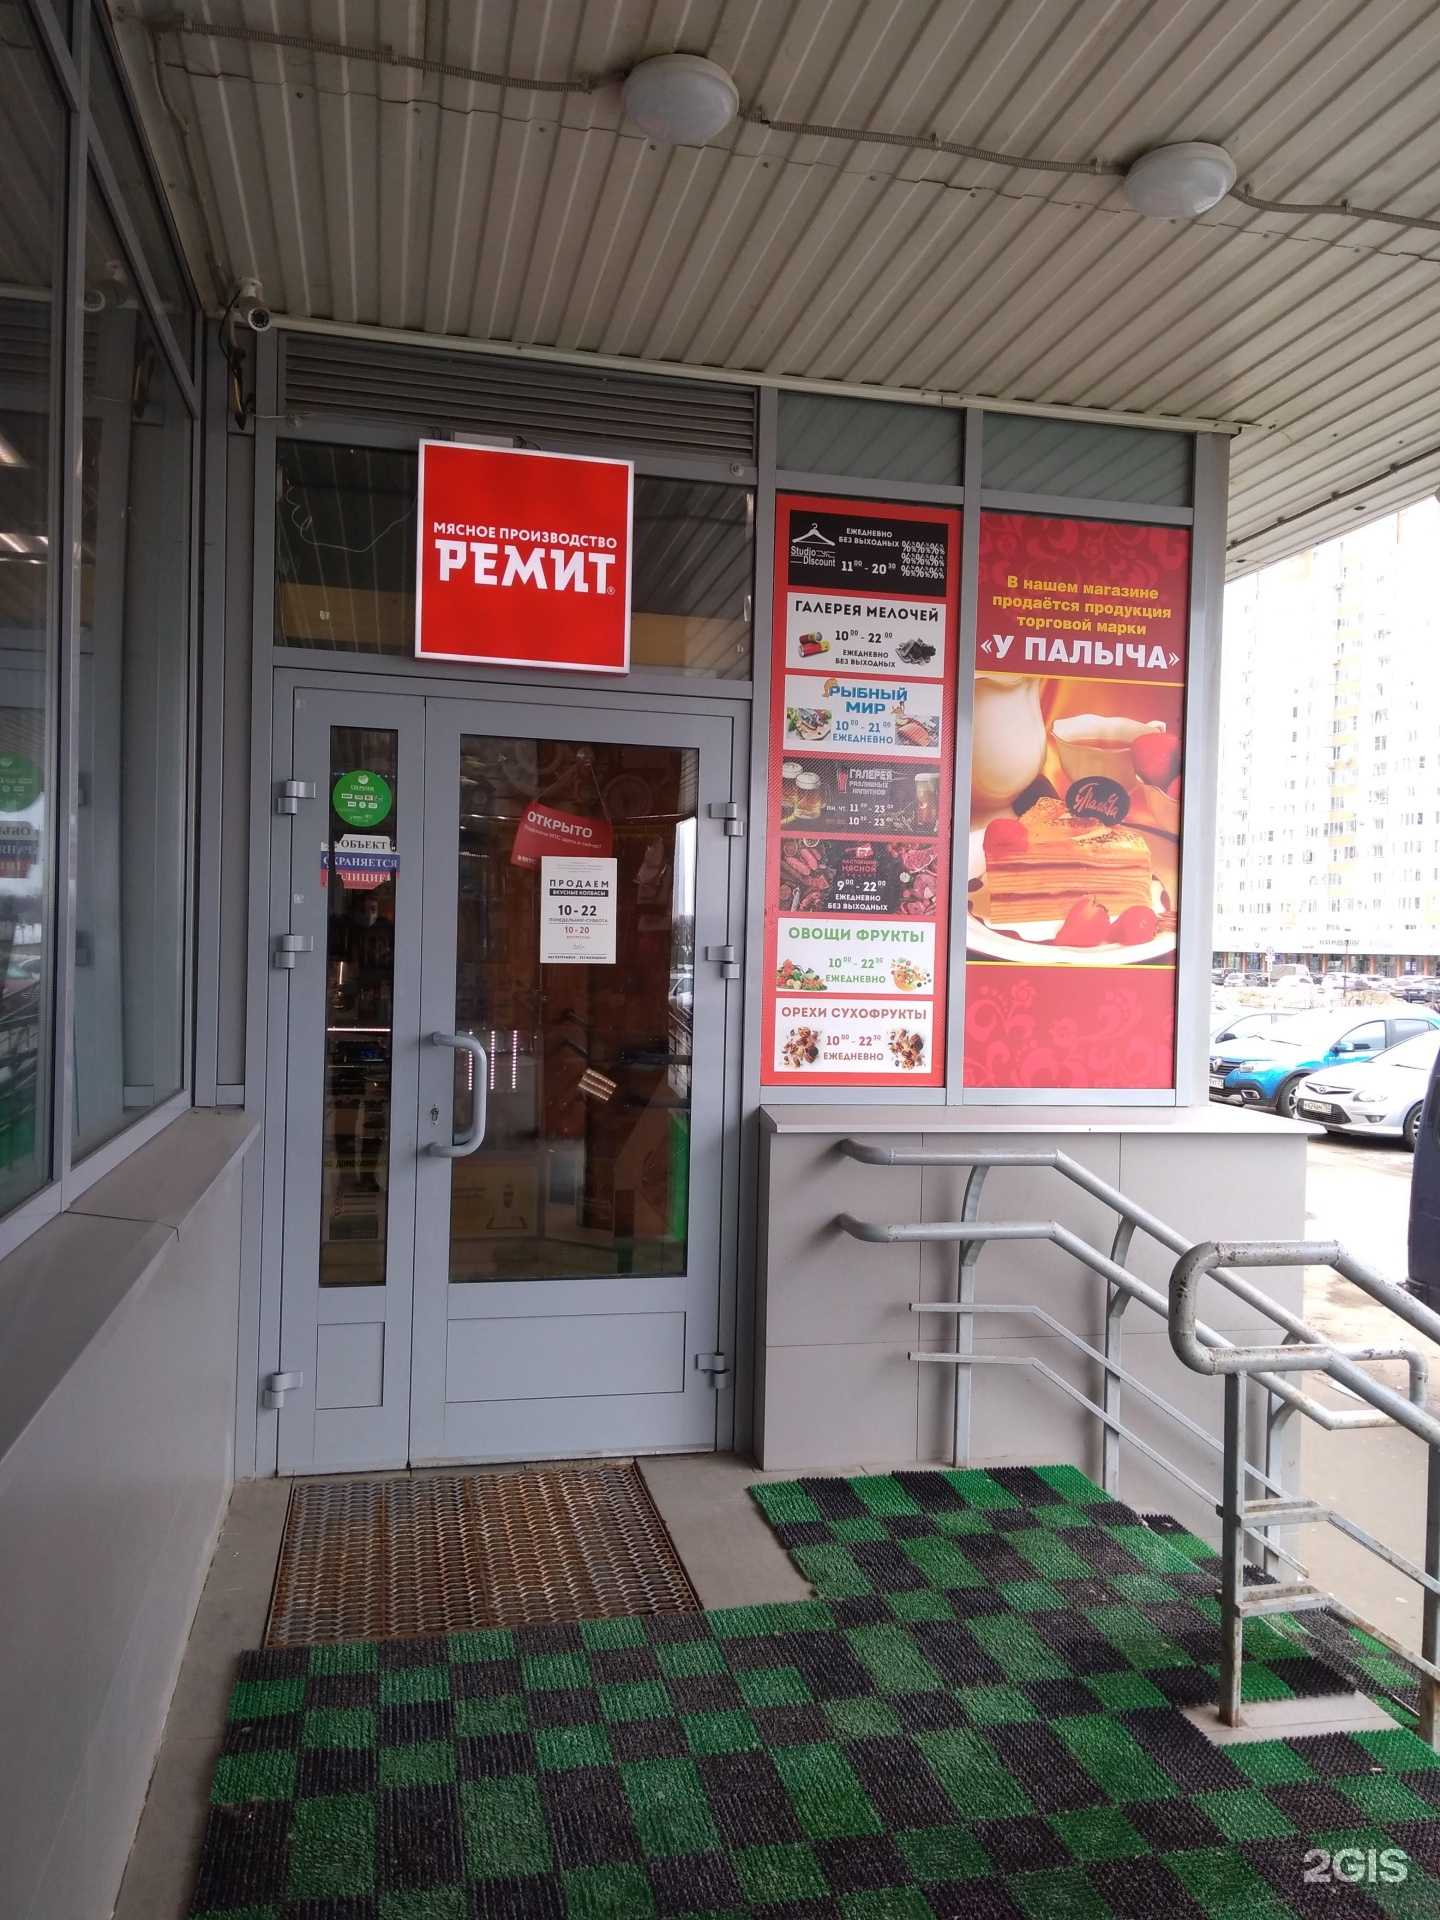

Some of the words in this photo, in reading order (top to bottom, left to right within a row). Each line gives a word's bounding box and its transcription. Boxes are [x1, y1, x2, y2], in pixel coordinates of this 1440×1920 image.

[433, 522, 496, 538] МЯСНОЕ
[500, 528, 617, 549] ПРОИЗВОДСТВО
[846, 527, 893, 538] ЕЖЕДНЕВНО
[838, 536, 852, 544] БЕЗ
[854, 538, 900, 548] ВЫХОДНЫХ
[790, 545, 817, 557] Studio
[435, 539, 616, 594] РЕМИТ
[1007, 575, 1018, 589] В
[1024, 579, 1079, 594] нашем
[1083, 583, 1159, 600] магазине
[795, 600, 861, 617] ГАЛЕРЕЯ
[866, 606, 939, 622] МЕЛОЧЕЙ
[992, 595, 1080, 612] продаётся
[1084, 603, 1172, 619] продукция
[1016, 616, 1092, 632] торговой
[1096, 622, 1147, 636] марки
[842, 649, 889, 659] ЕЖЕДНЕВНО
[1024, 636, 1181, 670] ПАЛЫЧА»
[851, 658, 896, 668] ВЫХОДНЫХ
[829, 685, 908, 701] РЫБНЫЙ
[846, 701, 886, 715] МИР
[832, 733, 894, 744] ЕЖЕДНЕВНО
[849, 768, 893, 780] ГАЛЕРЕЯ
[527, 811, 593, 838] ОТКРЫТО
[341, 839, 387, 850] ОБЪЕКТ
[549, 879, 609, 888] ПРОДАЕМ
[835, 893, 881, 902] ЕЖЕДНЕВНО
[827, 902, 842, 910] БЕЗ
[843, 902, 888, 911] ВЫХОДНЫХ
[788, 926, 850, 942] ОВОЩИ
[856, 927, 924, 943] ФРУКТЫ
[825, 974, 886, 984] ЕЖЕДНЕВНО
[781, 1006, 827, 1018] ОРЕХИ
[831, 1008, 927, 1020] СУХОФРУКТЫ
[823, 1052, 884, 1061] ЕЖЕДНЕВНО
